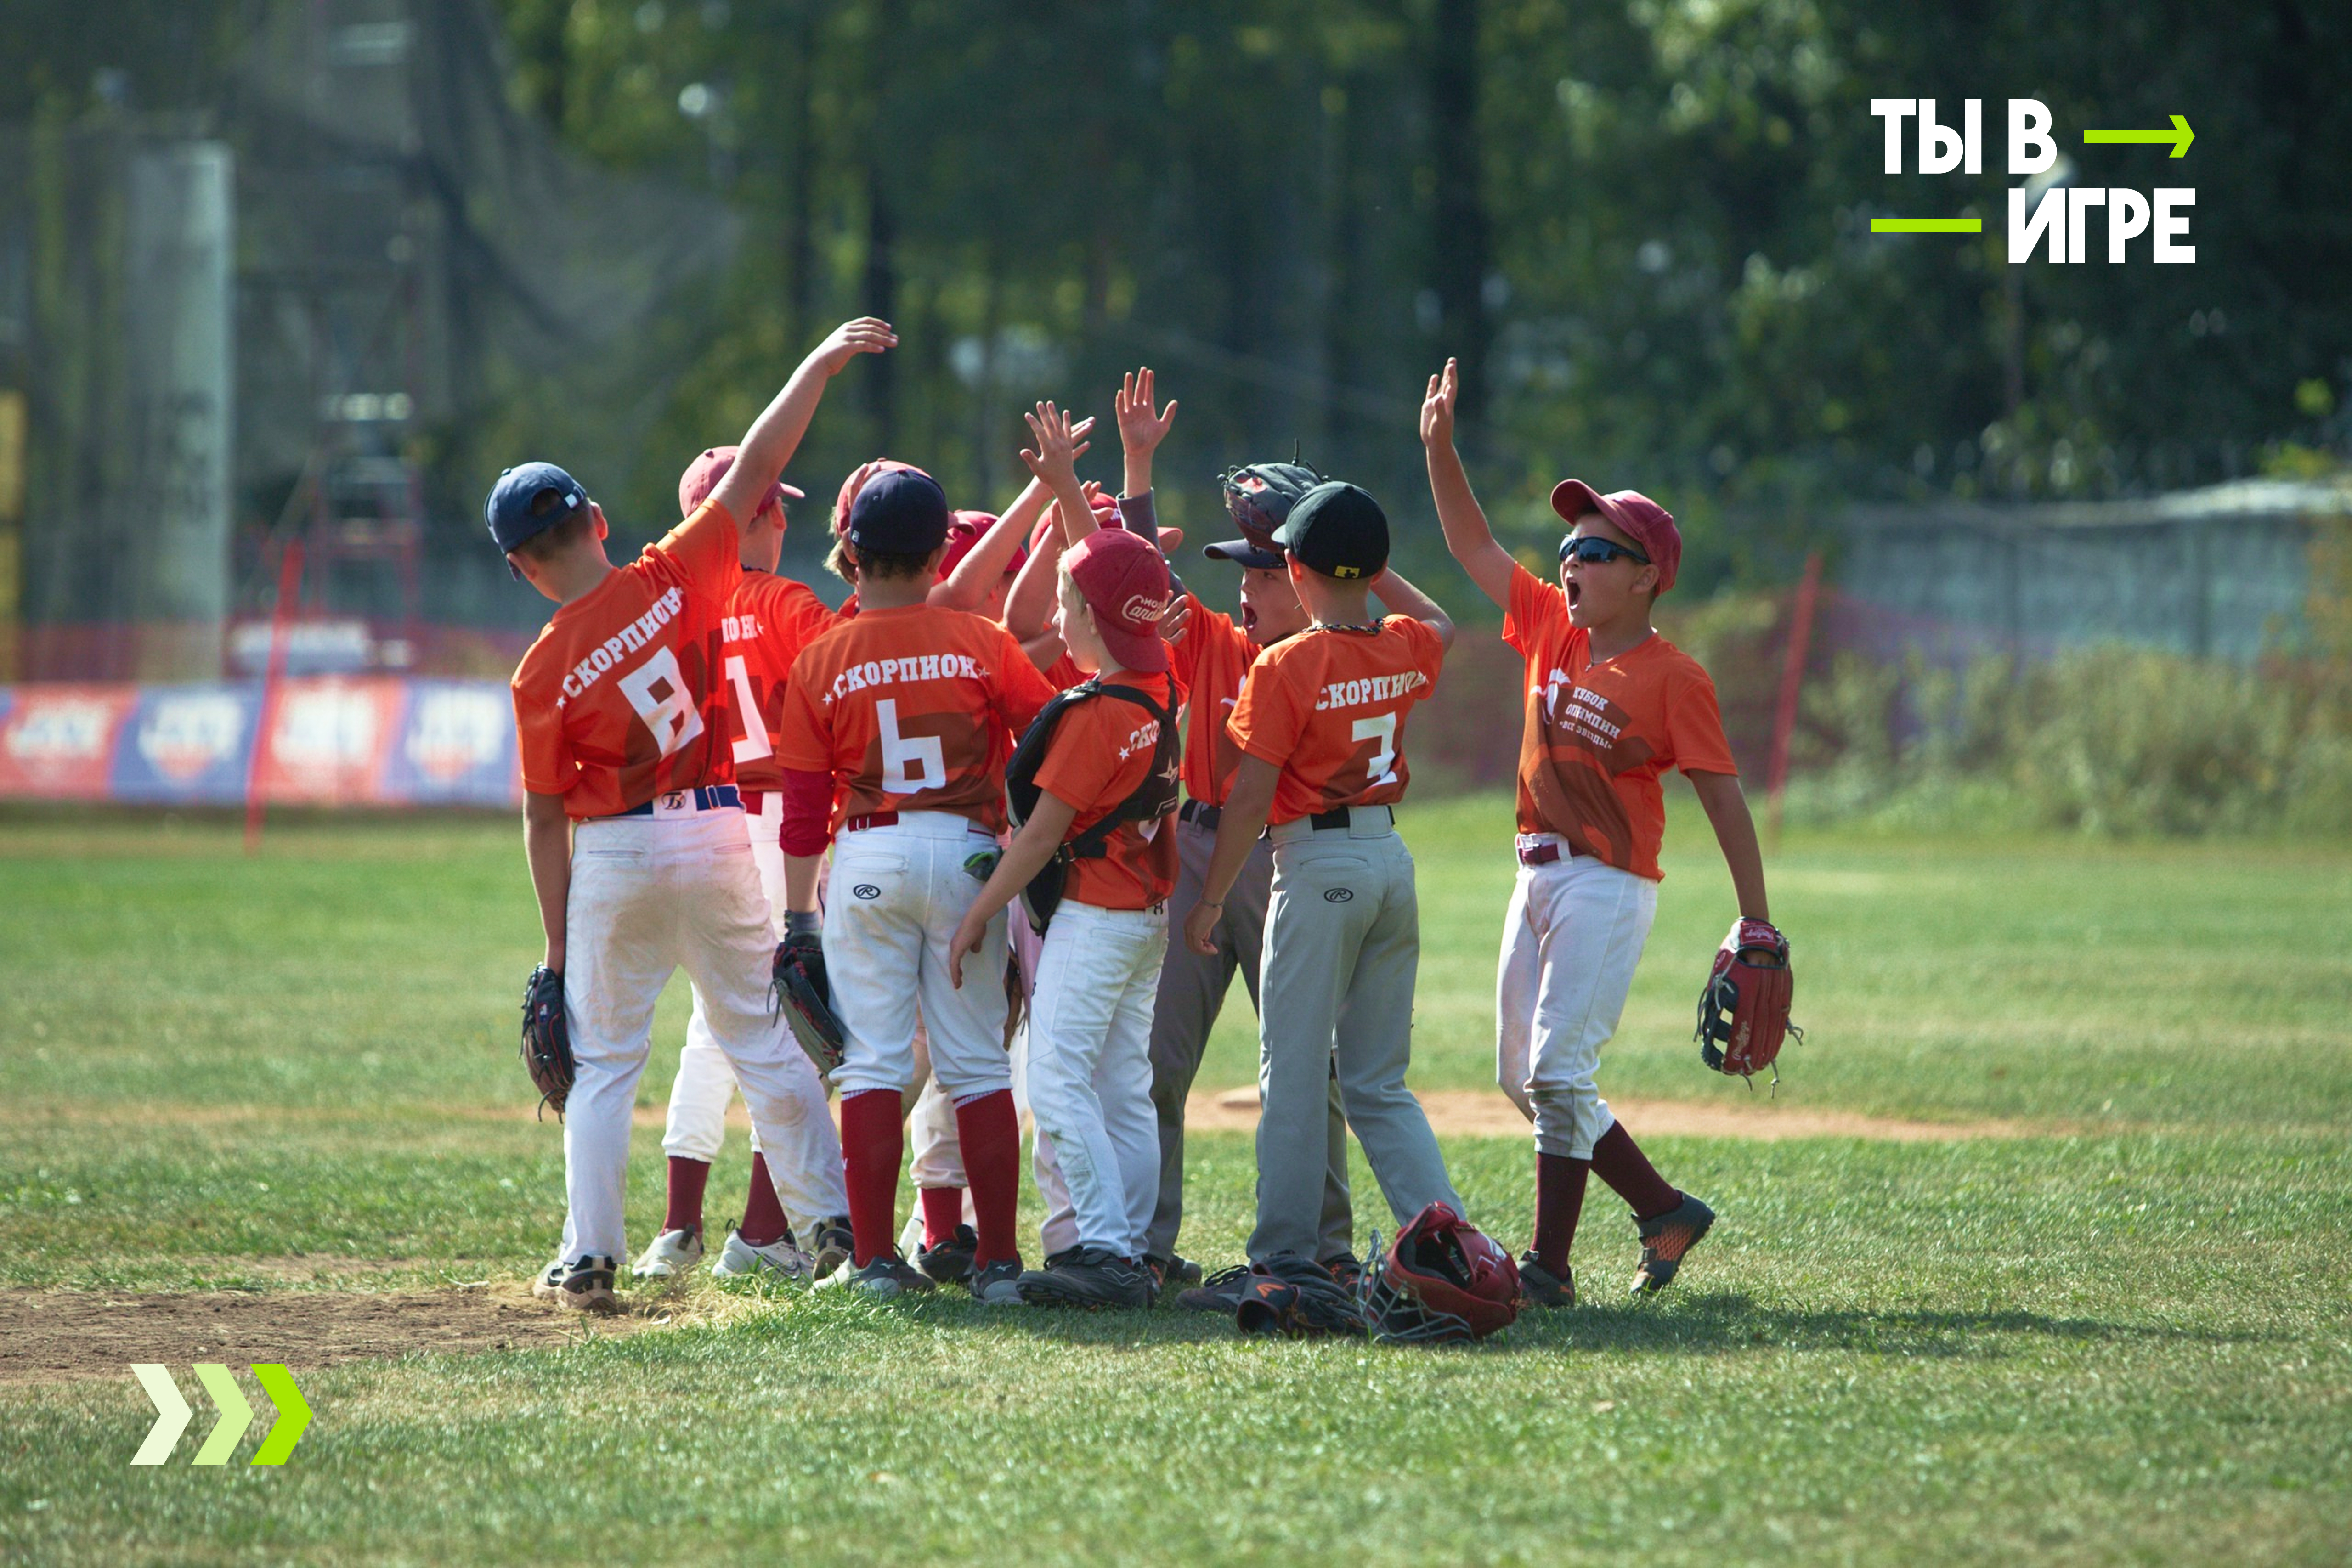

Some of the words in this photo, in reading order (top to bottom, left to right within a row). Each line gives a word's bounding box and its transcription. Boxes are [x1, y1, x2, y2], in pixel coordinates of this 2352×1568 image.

[725, 655, 773, 763] 1
[832, 654, 979, 699] СКОРПИОН
[1573, 686, 1609, 711] КУБОК
[876, 698, 946, 794] 6
